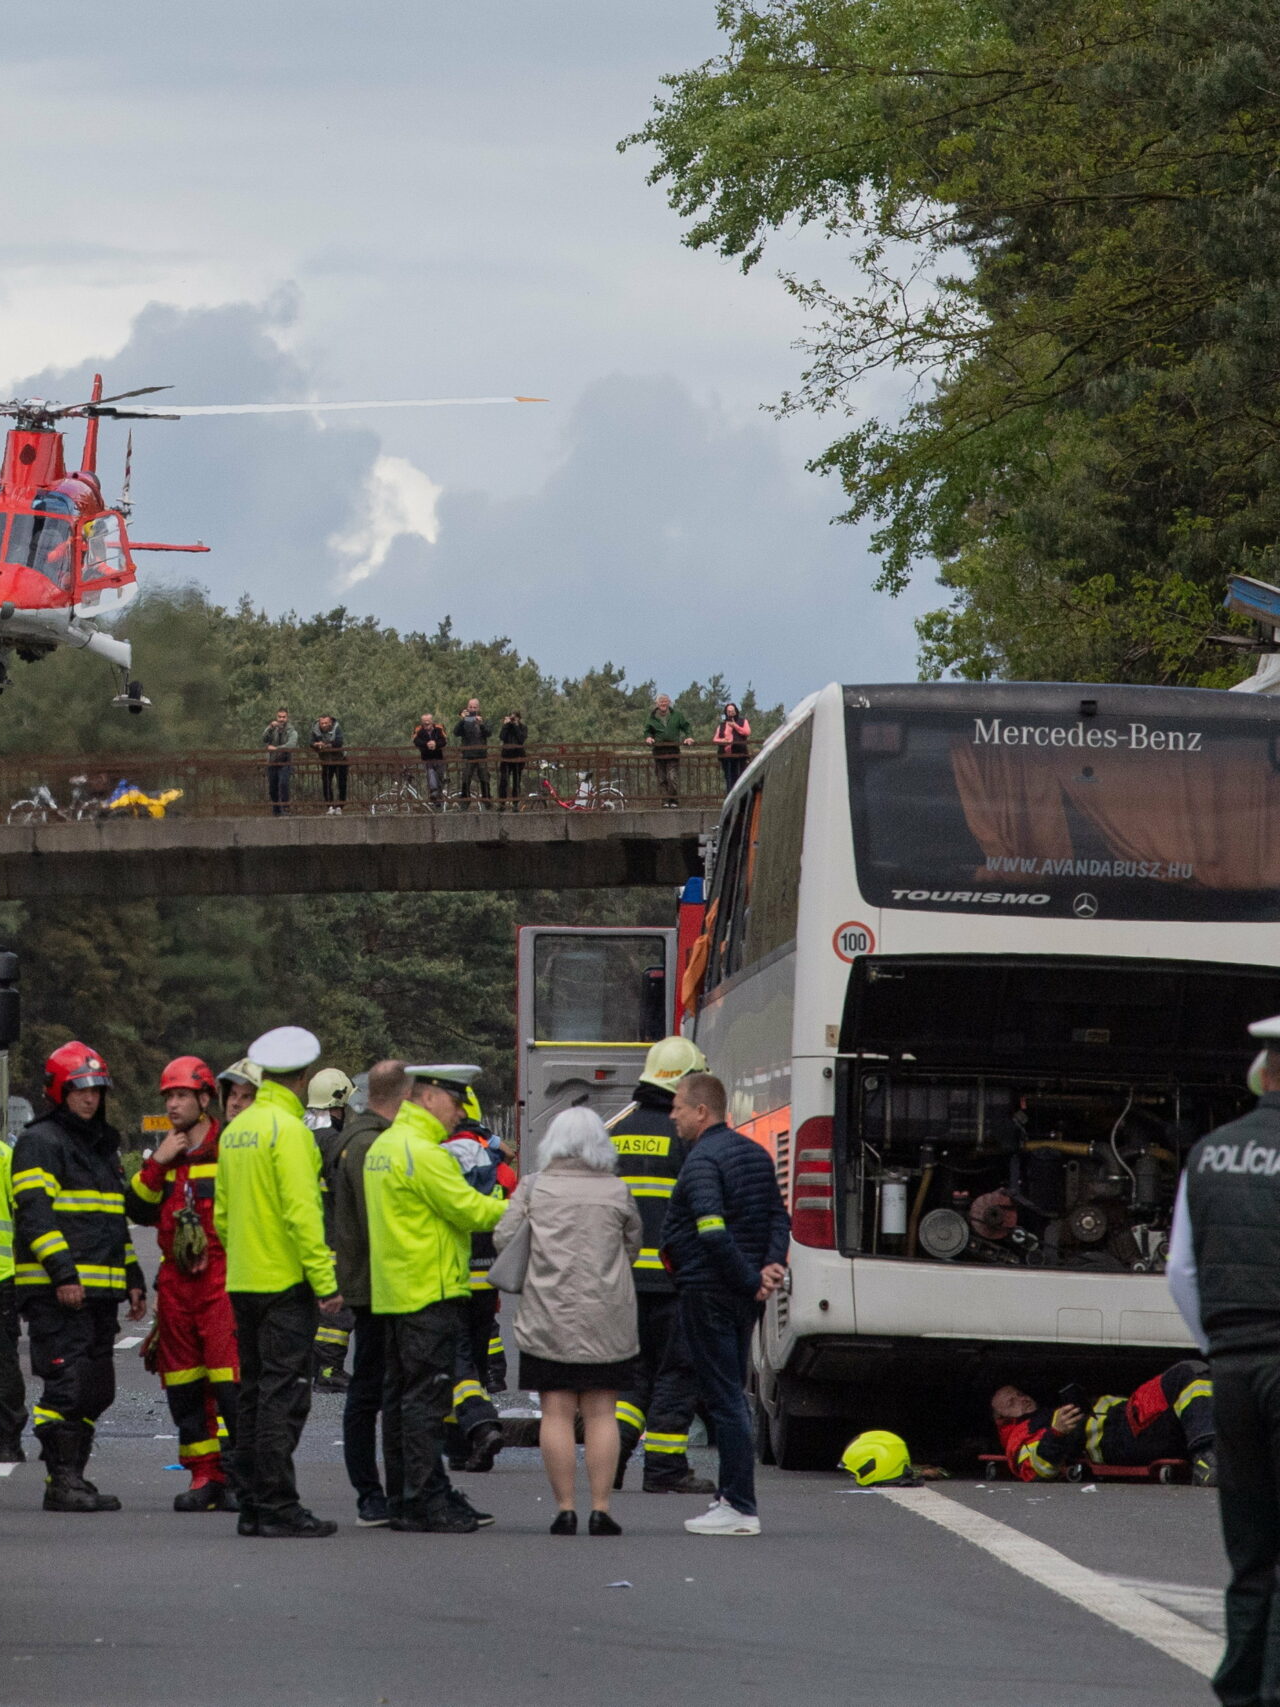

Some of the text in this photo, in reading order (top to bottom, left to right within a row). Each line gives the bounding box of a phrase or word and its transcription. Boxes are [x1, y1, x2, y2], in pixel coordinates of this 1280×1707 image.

[972, 717, 1202, 751] Mercedes-Benz
[986, 855, 1194, 879] WWW.AVANDABUSZ.HU
[890, 888, 1052, 906] TOURISMO
[840, 932, 868, 952] 100
